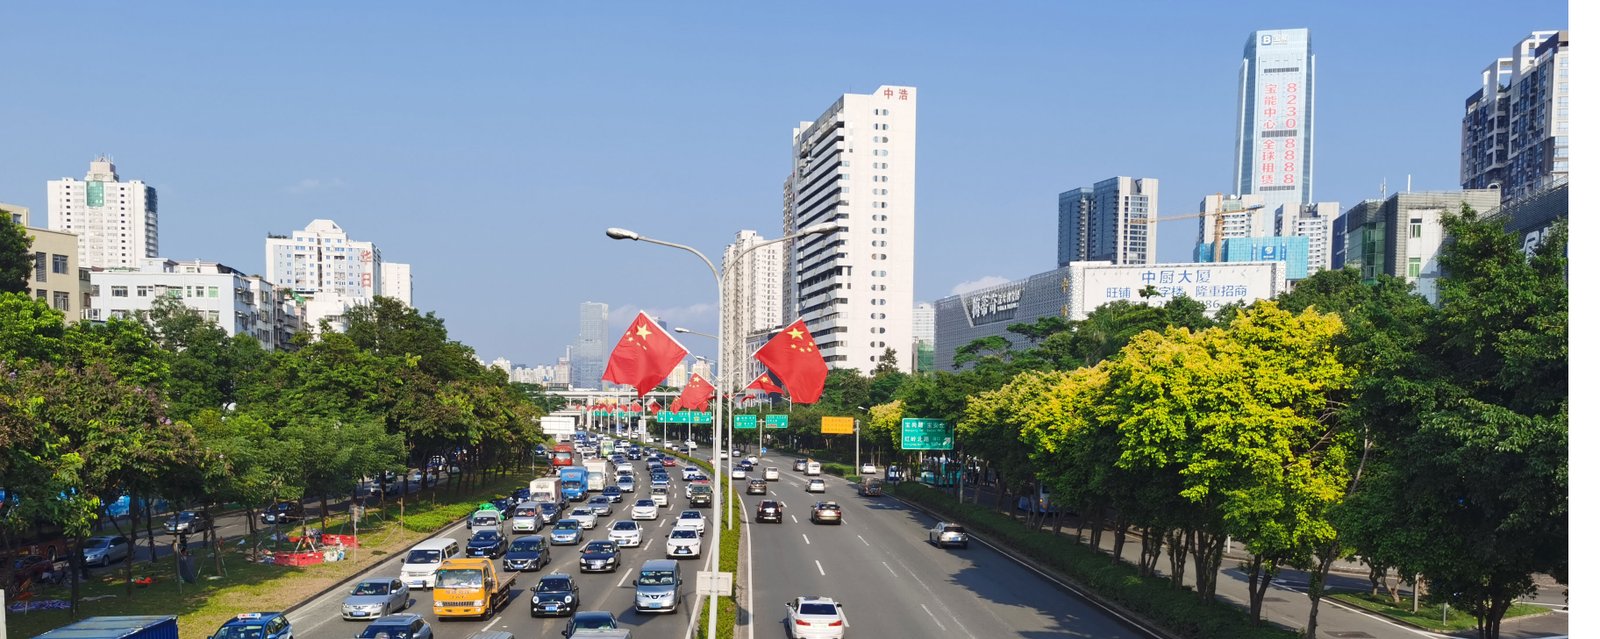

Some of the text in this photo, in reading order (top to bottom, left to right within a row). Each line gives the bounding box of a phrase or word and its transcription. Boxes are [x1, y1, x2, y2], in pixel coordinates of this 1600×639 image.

[884, 87, 908, 101] 中浩
[1263, 84, 1277, 129] 宝能中心
[1283, 138, 1296, 185] 8888
[1141, 269, 1211, 284] 中厨大厦
[1106, 287, 1131, 299] 旺铺
[1151, 286, 1185, 298] 字楼
